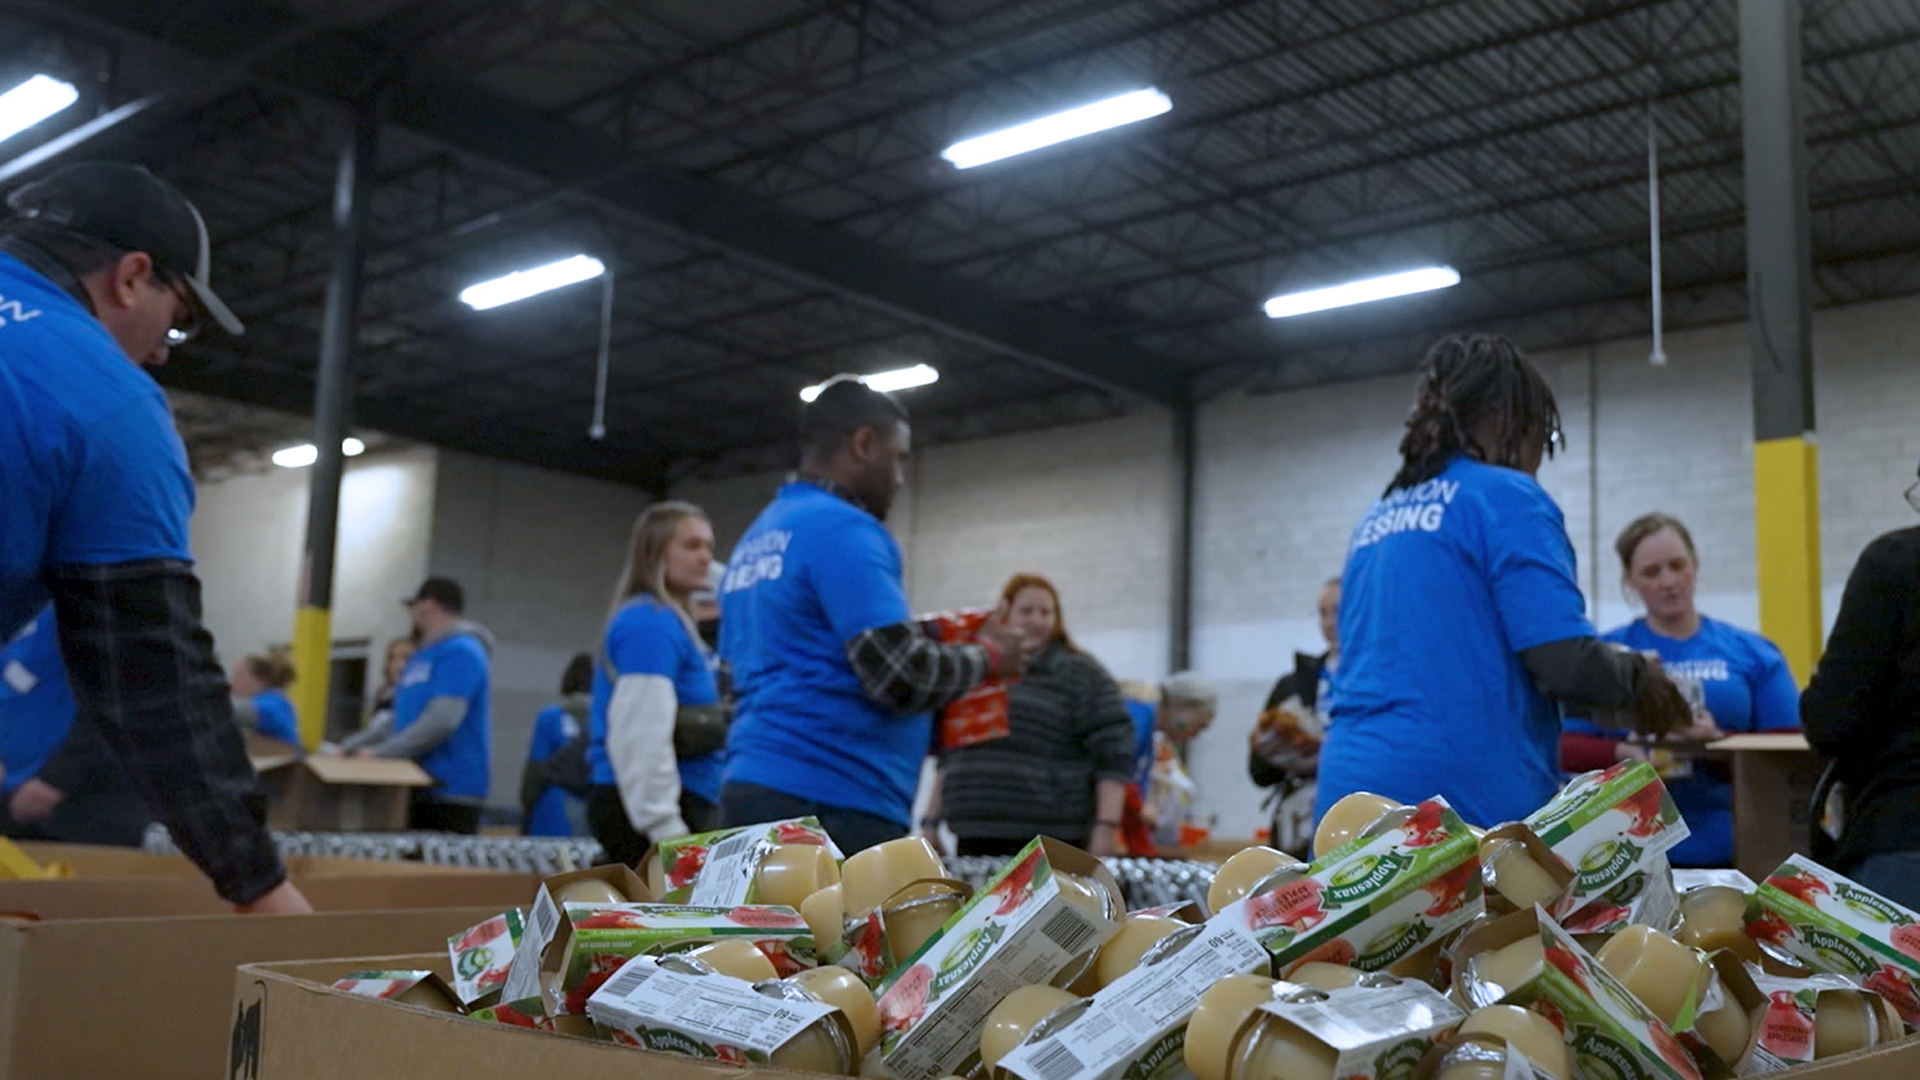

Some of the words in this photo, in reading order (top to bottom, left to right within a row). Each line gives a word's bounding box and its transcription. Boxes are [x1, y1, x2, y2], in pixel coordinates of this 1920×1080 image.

[1333, 857, 1398, 899] Applesnax
[1580, 847, 1631, 886] Applesnax
[1845, 889, 1902, 922] Applesnax
[936, 931, 993, 988] Applesnax
[1811, 932, 1868, 970] Applesnax
